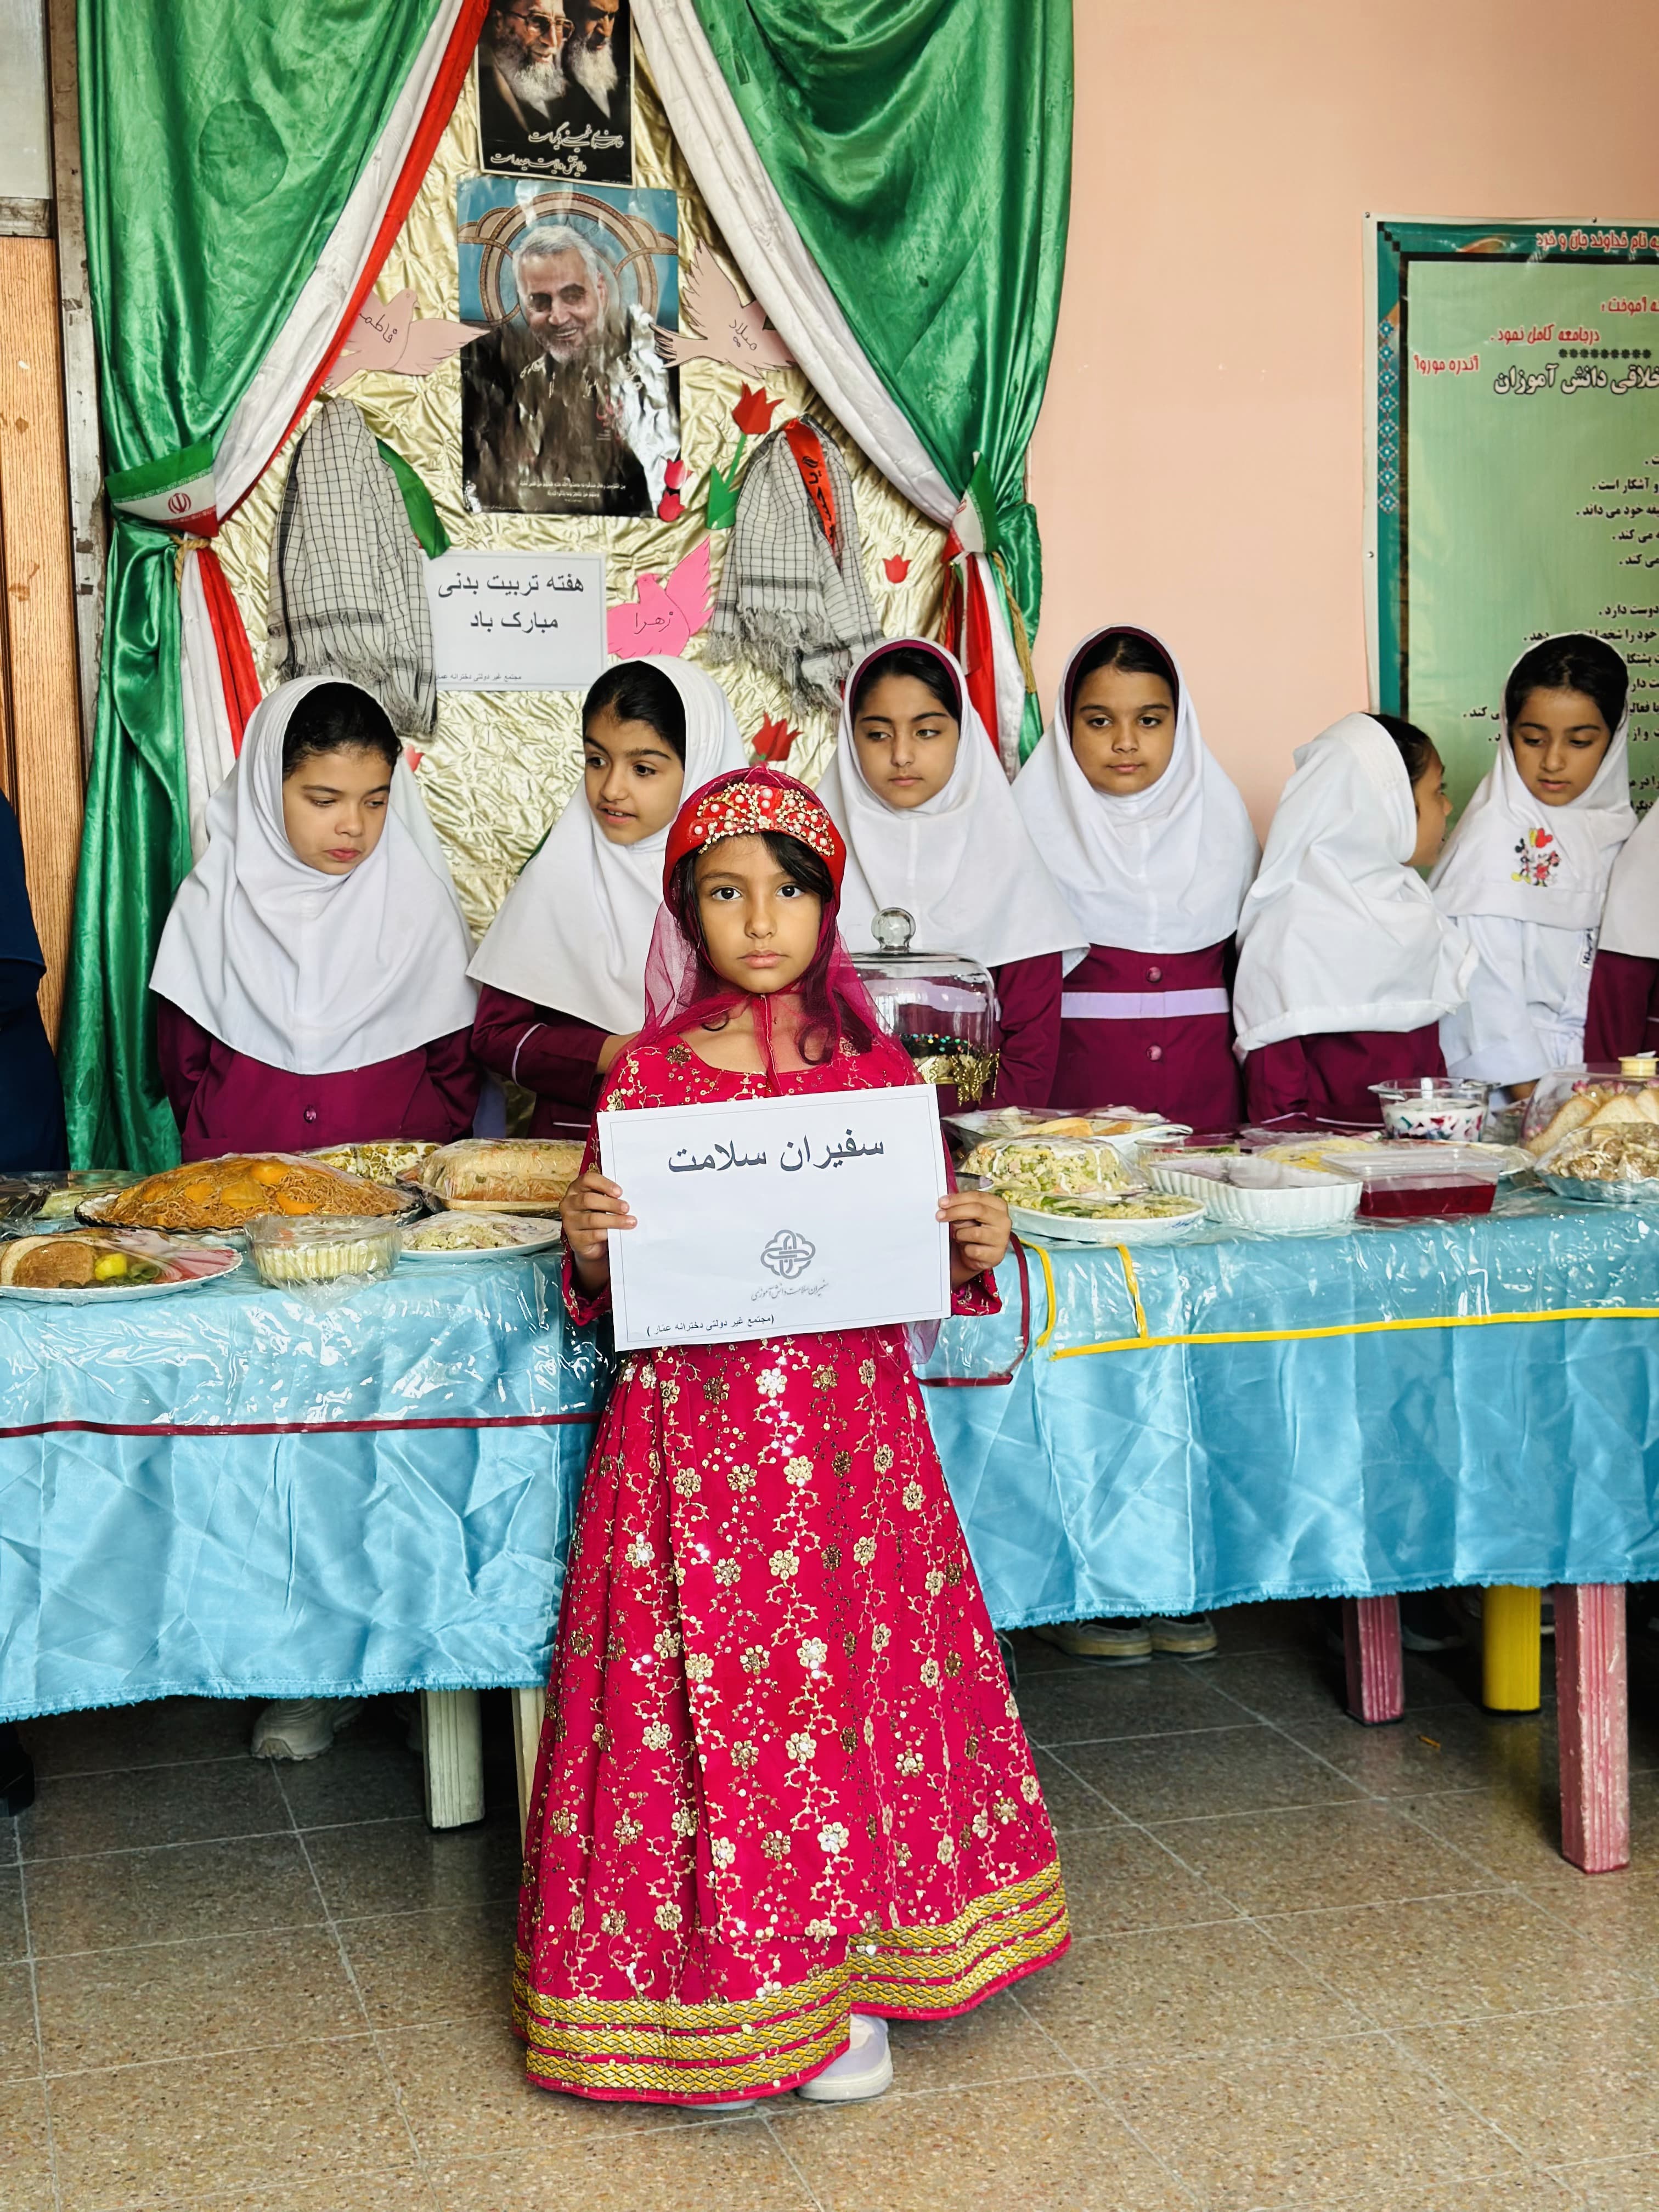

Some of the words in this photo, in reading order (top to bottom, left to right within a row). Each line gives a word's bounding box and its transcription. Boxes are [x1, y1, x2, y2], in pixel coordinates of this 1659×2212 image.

[1536, 229, 1557, 251] خرد
[1558, 233, 1567, 251] و
[1569, 229, 1589, 251] جان
[1590, 230, 1628, 253] خداوند
[1630, 230, 1647, 253] نام
[359, 313, 398, 343] فاطم
[1527, 323, 1556, 345] کامل
[1449, 354, 1479, 375] آندره
[1493, 363, 1559, 395] آموزان
[1561, 365, 1608, 395] دانش
[1622, 477, 1650, 494] آشکار
[1606, 508, 1621, 518] می
[1624, 503, 1644, 518] خود
[1638, 533, 1653, 543] می
[438, 573, 479, 597] بدنی
[487, 574, 539, 596] تربیت
[546, 573, 584, 592] هفته
[1630, 606, 1659, 618] دوست
[470, 611, 493, 632] باد
[501, 611, 558, 633] مبارک
[634, 611, 674, 634] زهرا
[1626, 629, 1634, 643] را
[1637, 628, 1657, 642] خود
[1627, 653, 1651, 667] پشتکا
[450, 673, 471, 681] دخترانه
[473, 673, 490, 681] دولتی
[492, 673, 501, 681] غیر
[668, 1140, 767, 1173] سلامت
[779, 1128, 884, 1171] سفیران
[771, 1283, 787, 1299] دانش
[786, 1286, 809, 1295] سلامت
[808, 1279, 829, 1296] سفیران
[675, 1322, 703, 1331] دخترانه
[706, 1320, 727, 1331] دولتی
[731, 1317, 743, 1328] غیر
